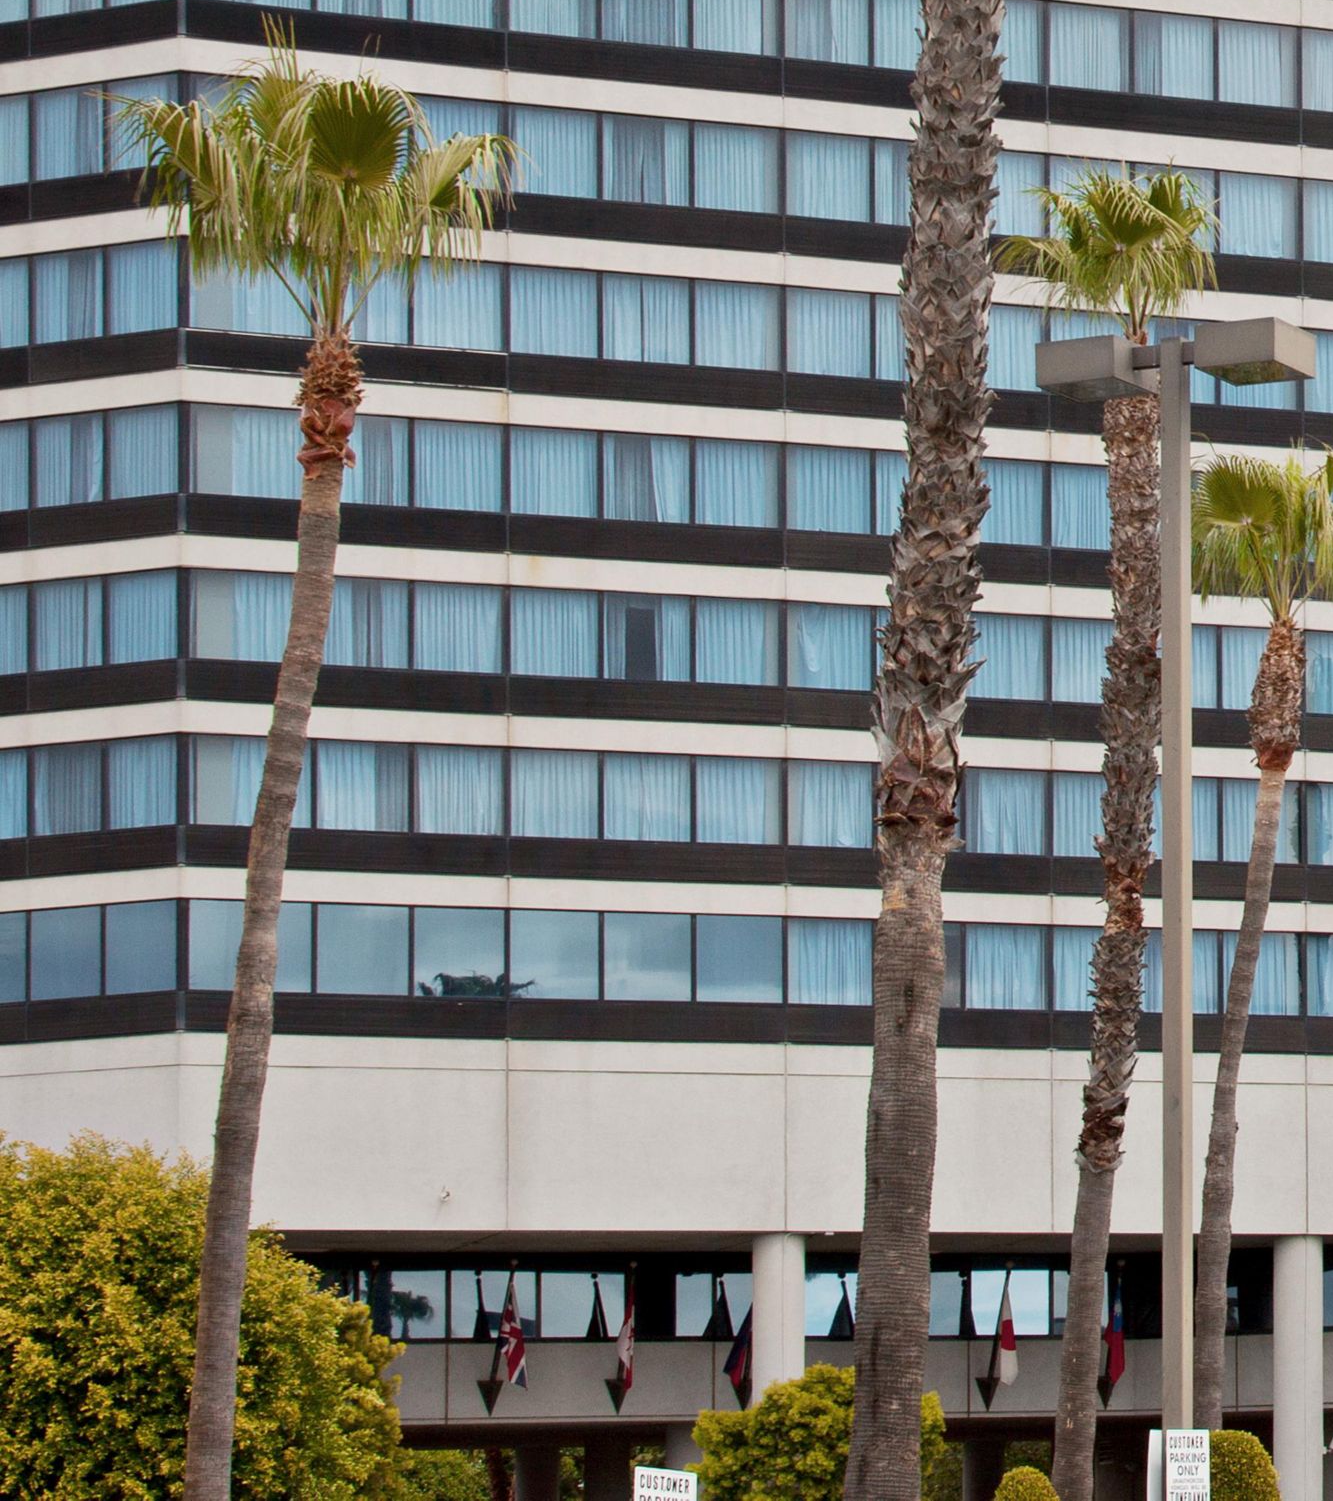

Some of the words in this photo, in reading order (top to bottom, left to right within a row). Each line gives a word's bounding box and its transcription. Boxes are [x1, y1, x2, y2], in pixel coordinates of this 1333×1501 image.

[1169, 1436, 1204, 1449] CUSTOMER
[1169, 1452, 1207, 1463] PARKING
[1177, 1465, 1200, 1476] ONLY
[640, 1474, 690, 1493] CUSTOMER
